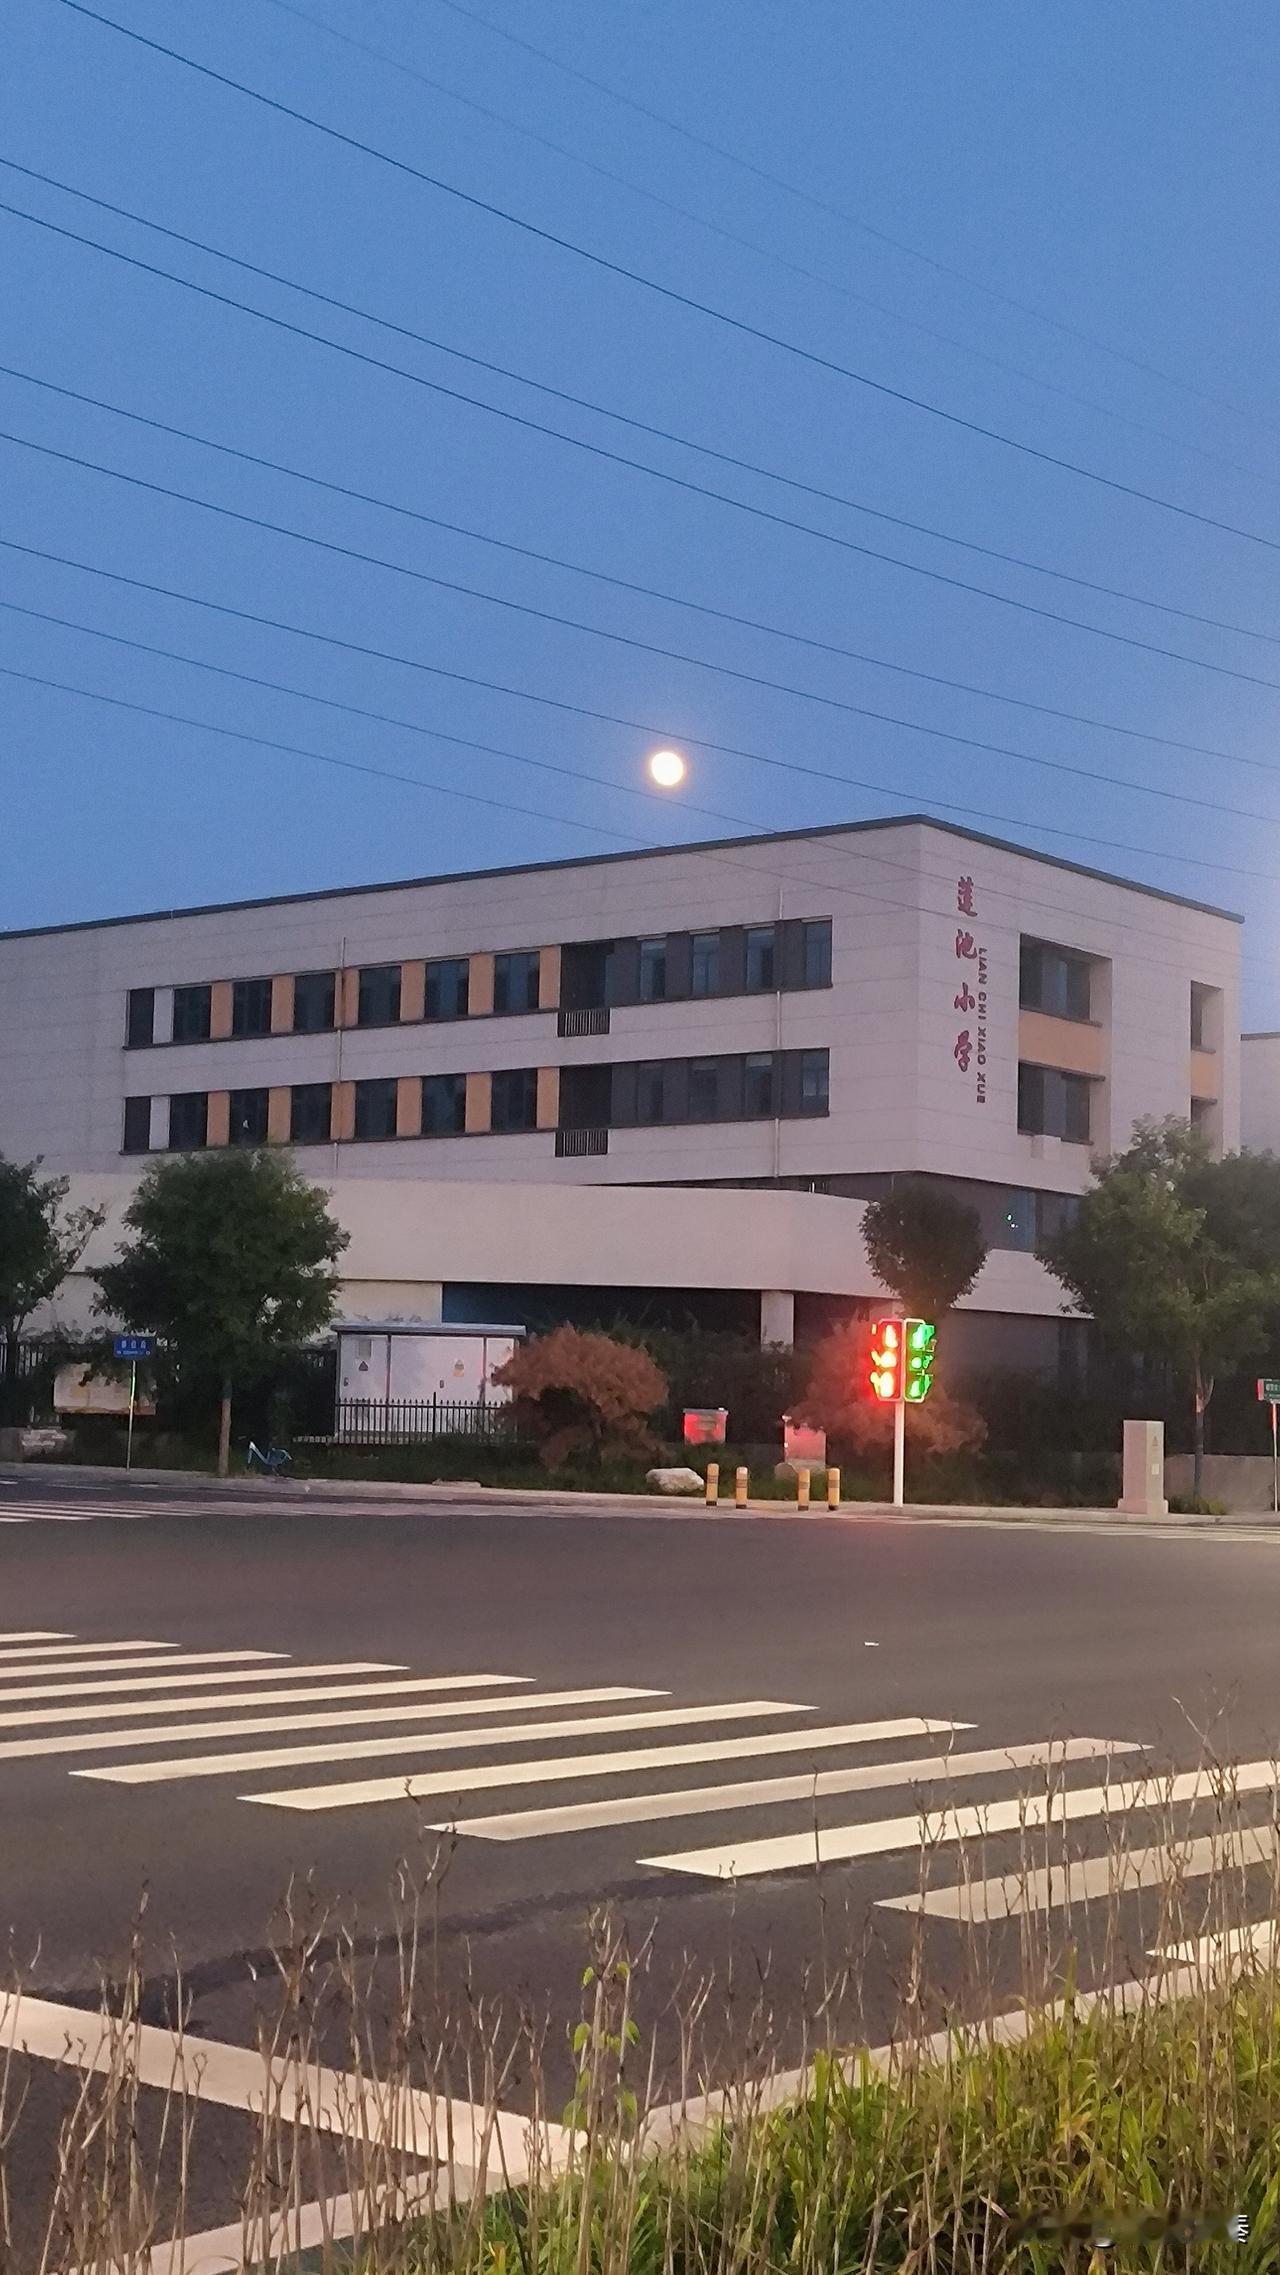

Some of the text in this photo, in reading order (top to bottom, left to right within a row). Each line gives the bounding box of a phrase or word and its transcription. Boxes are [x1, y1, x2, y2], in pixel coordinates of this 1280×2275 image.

[978, 947, 988, 984] LIAN
[978, 991, 987, 1020] CHI
[977, 1026, 987, 1065] XIAO
